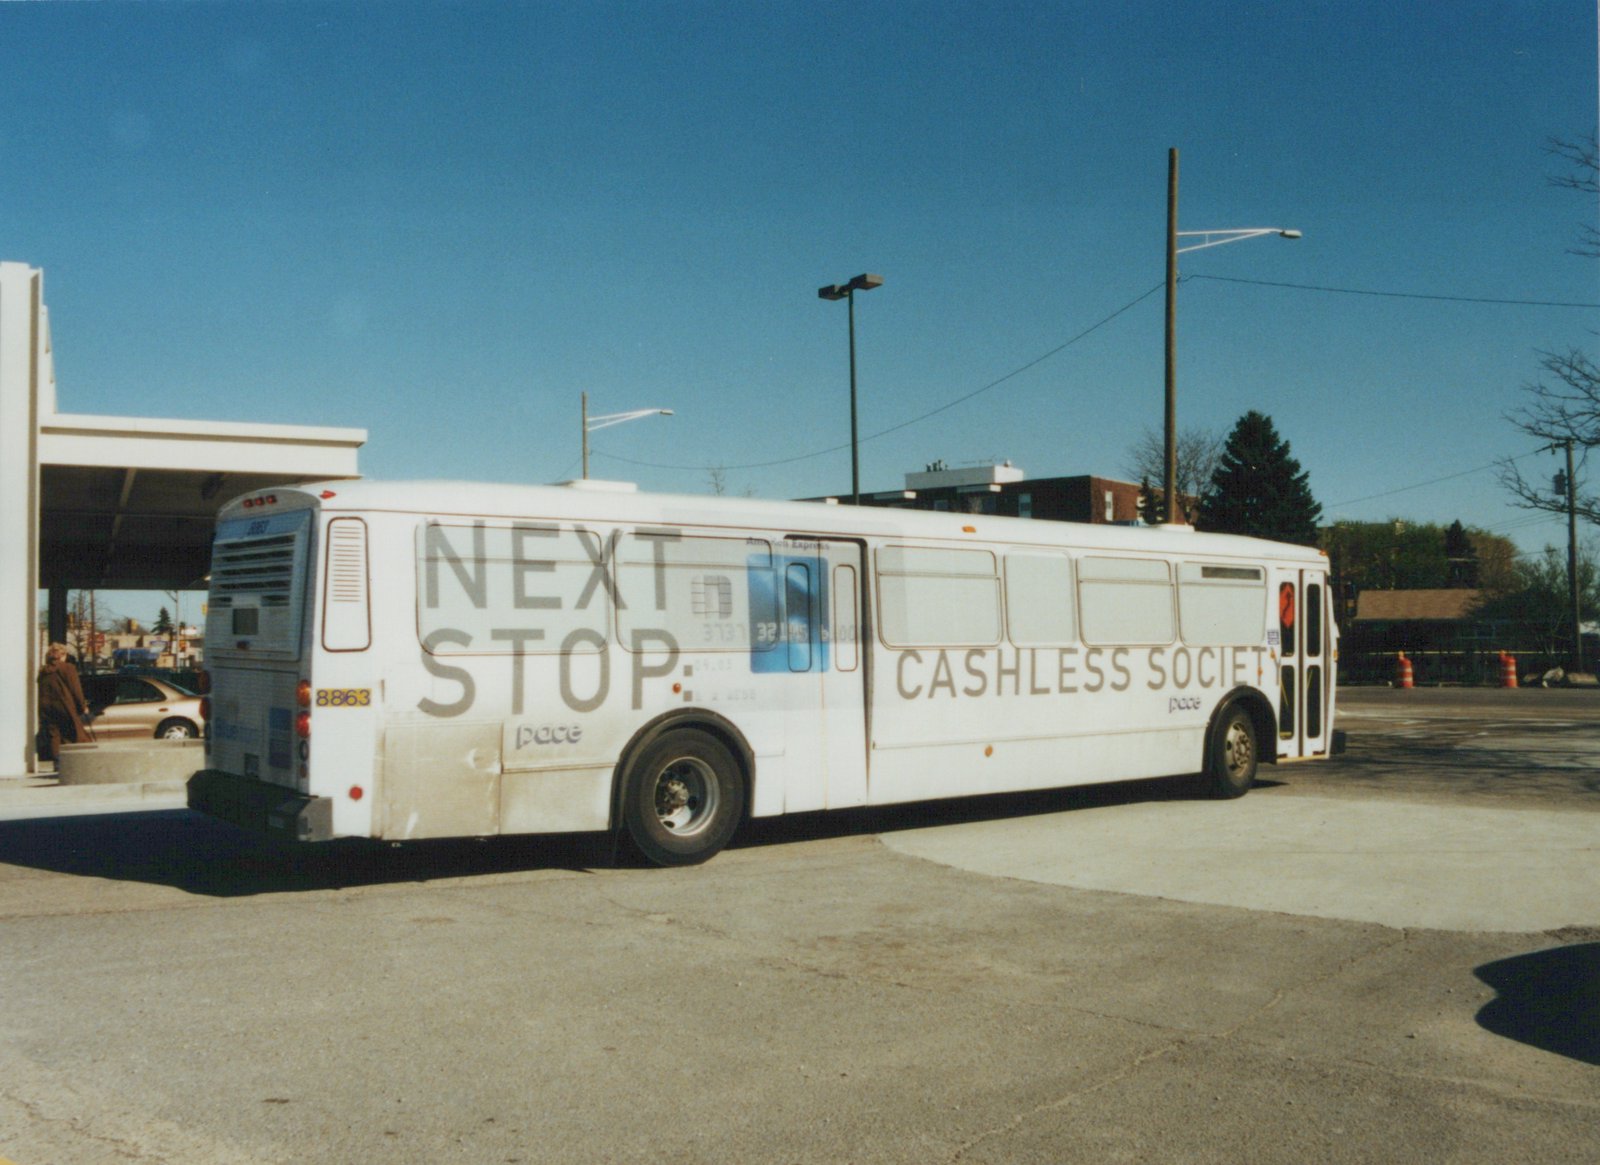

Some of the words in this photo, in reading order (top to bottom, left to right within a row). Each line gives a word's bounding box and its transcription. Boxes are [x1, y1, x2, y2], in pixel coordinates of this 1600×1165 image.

[424, 518, 683, 611] NEXT
[317, 689, 371, 707] 8863
[416, 627, 694, 719] STOP:
[896, 646, 1132, 701] CASHLESS
[1146, 645, 1282, 691] SOCIETY
[515, 723, 583, 750] pace
